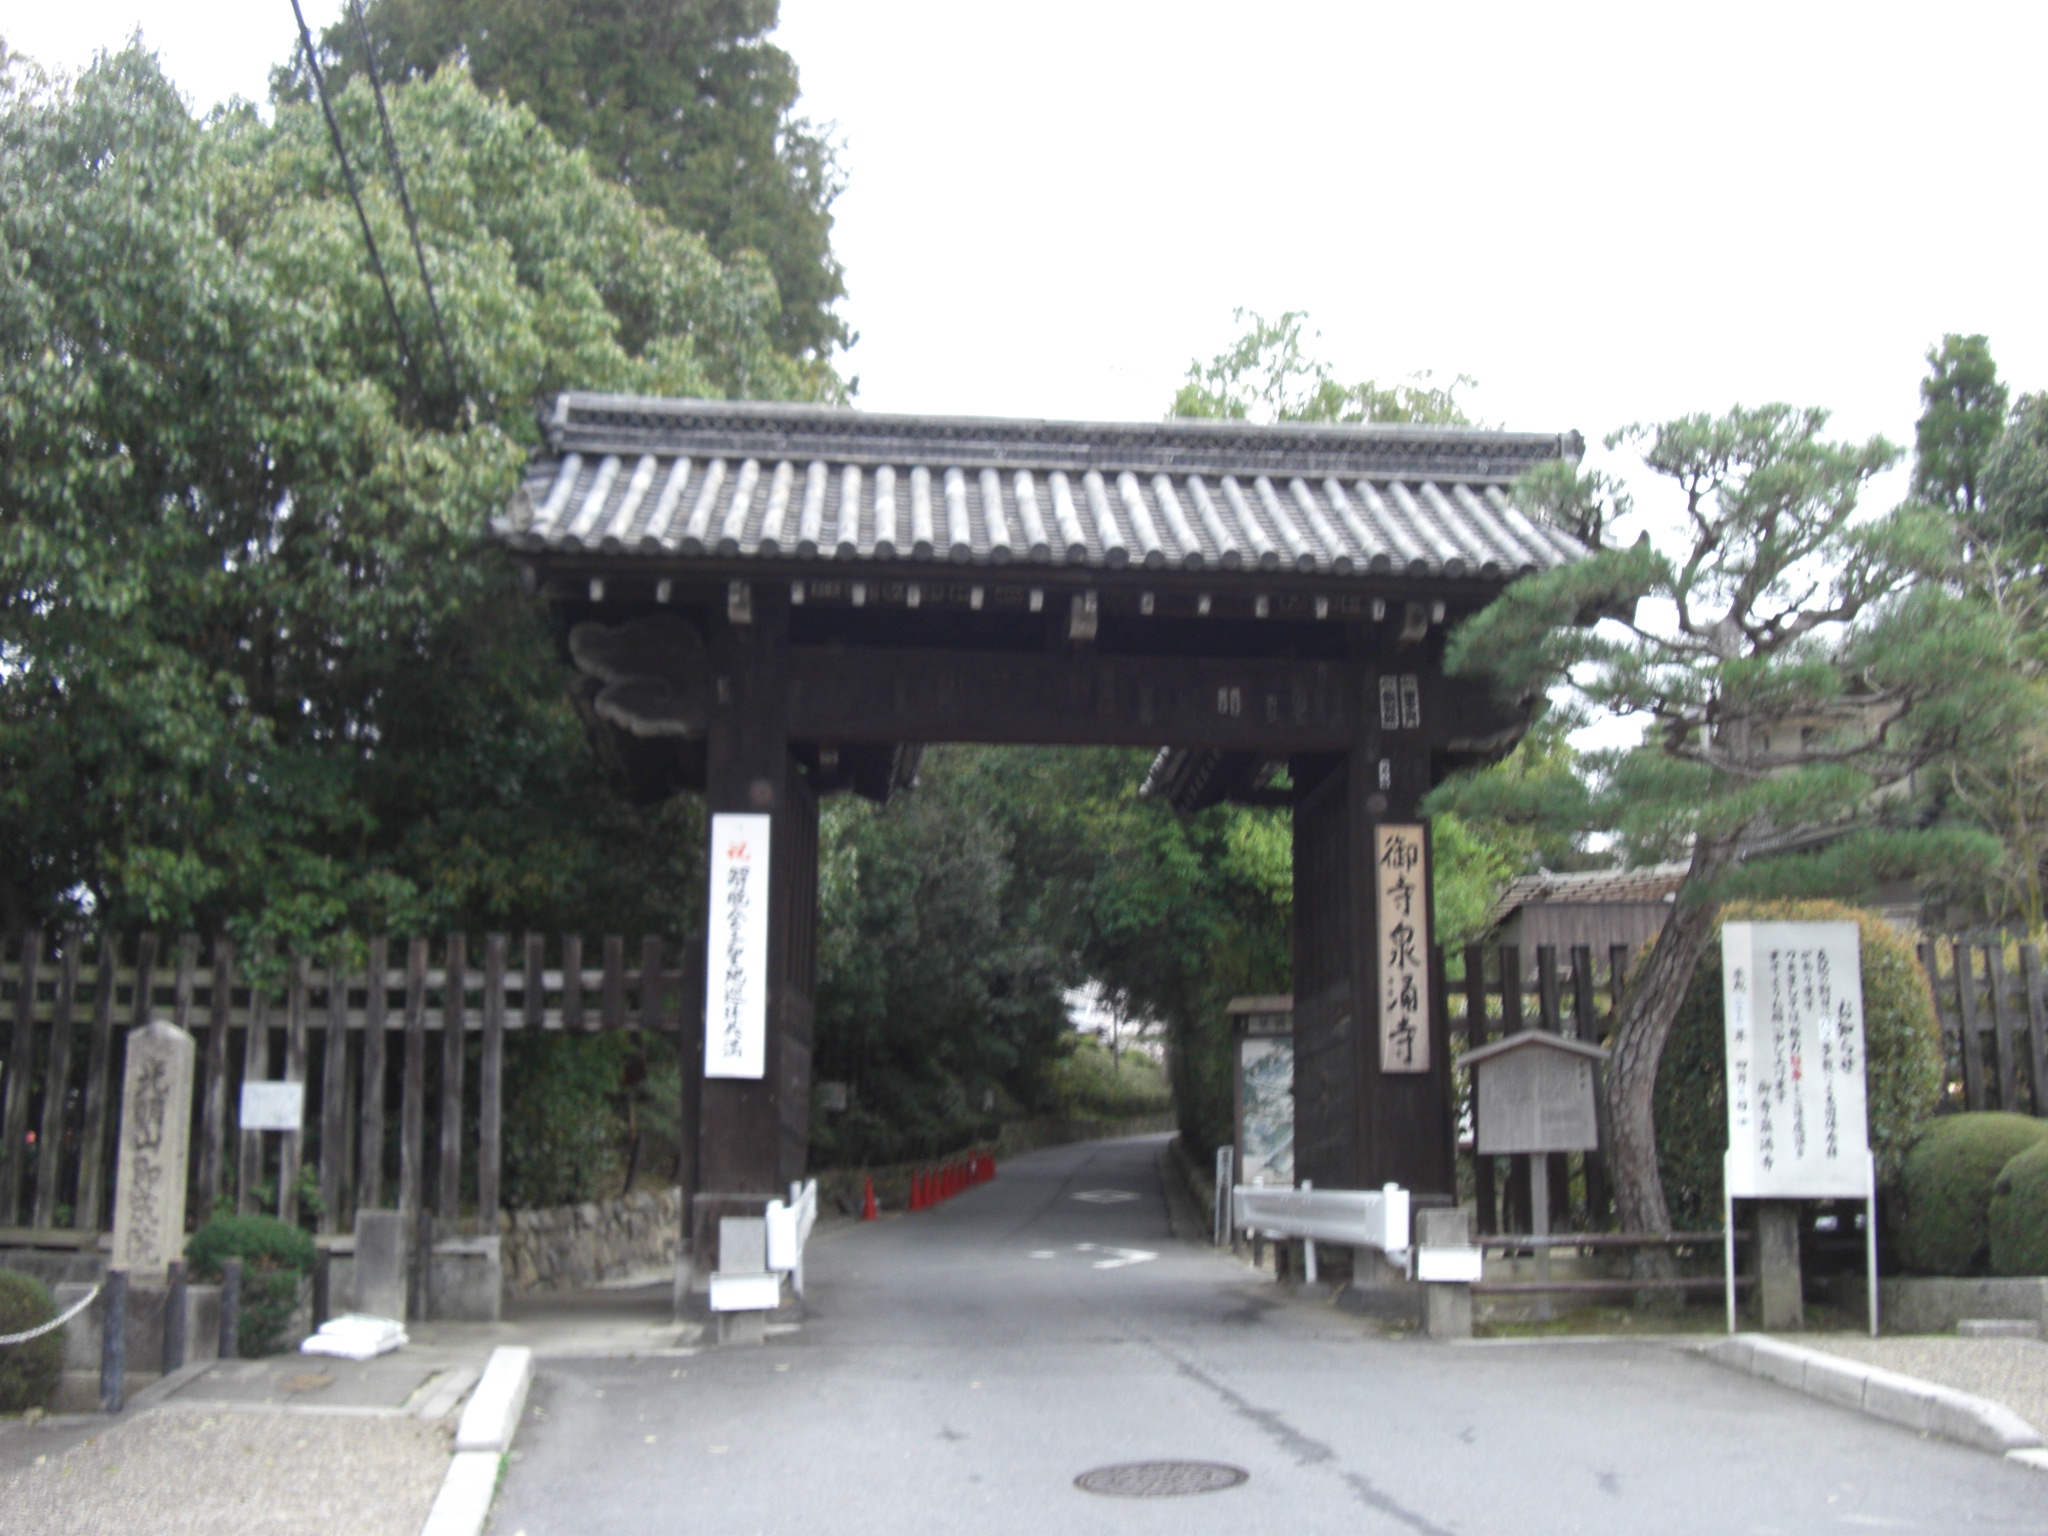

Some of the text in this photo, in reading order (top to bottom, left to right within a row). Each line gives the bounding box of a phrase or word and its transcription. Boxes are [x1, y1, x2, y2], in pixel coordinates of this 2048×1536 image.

[1380, 834, 1421, 1066] 御寺泉涌寺
[1838, 1000, 1853, 1074] お知らせ
